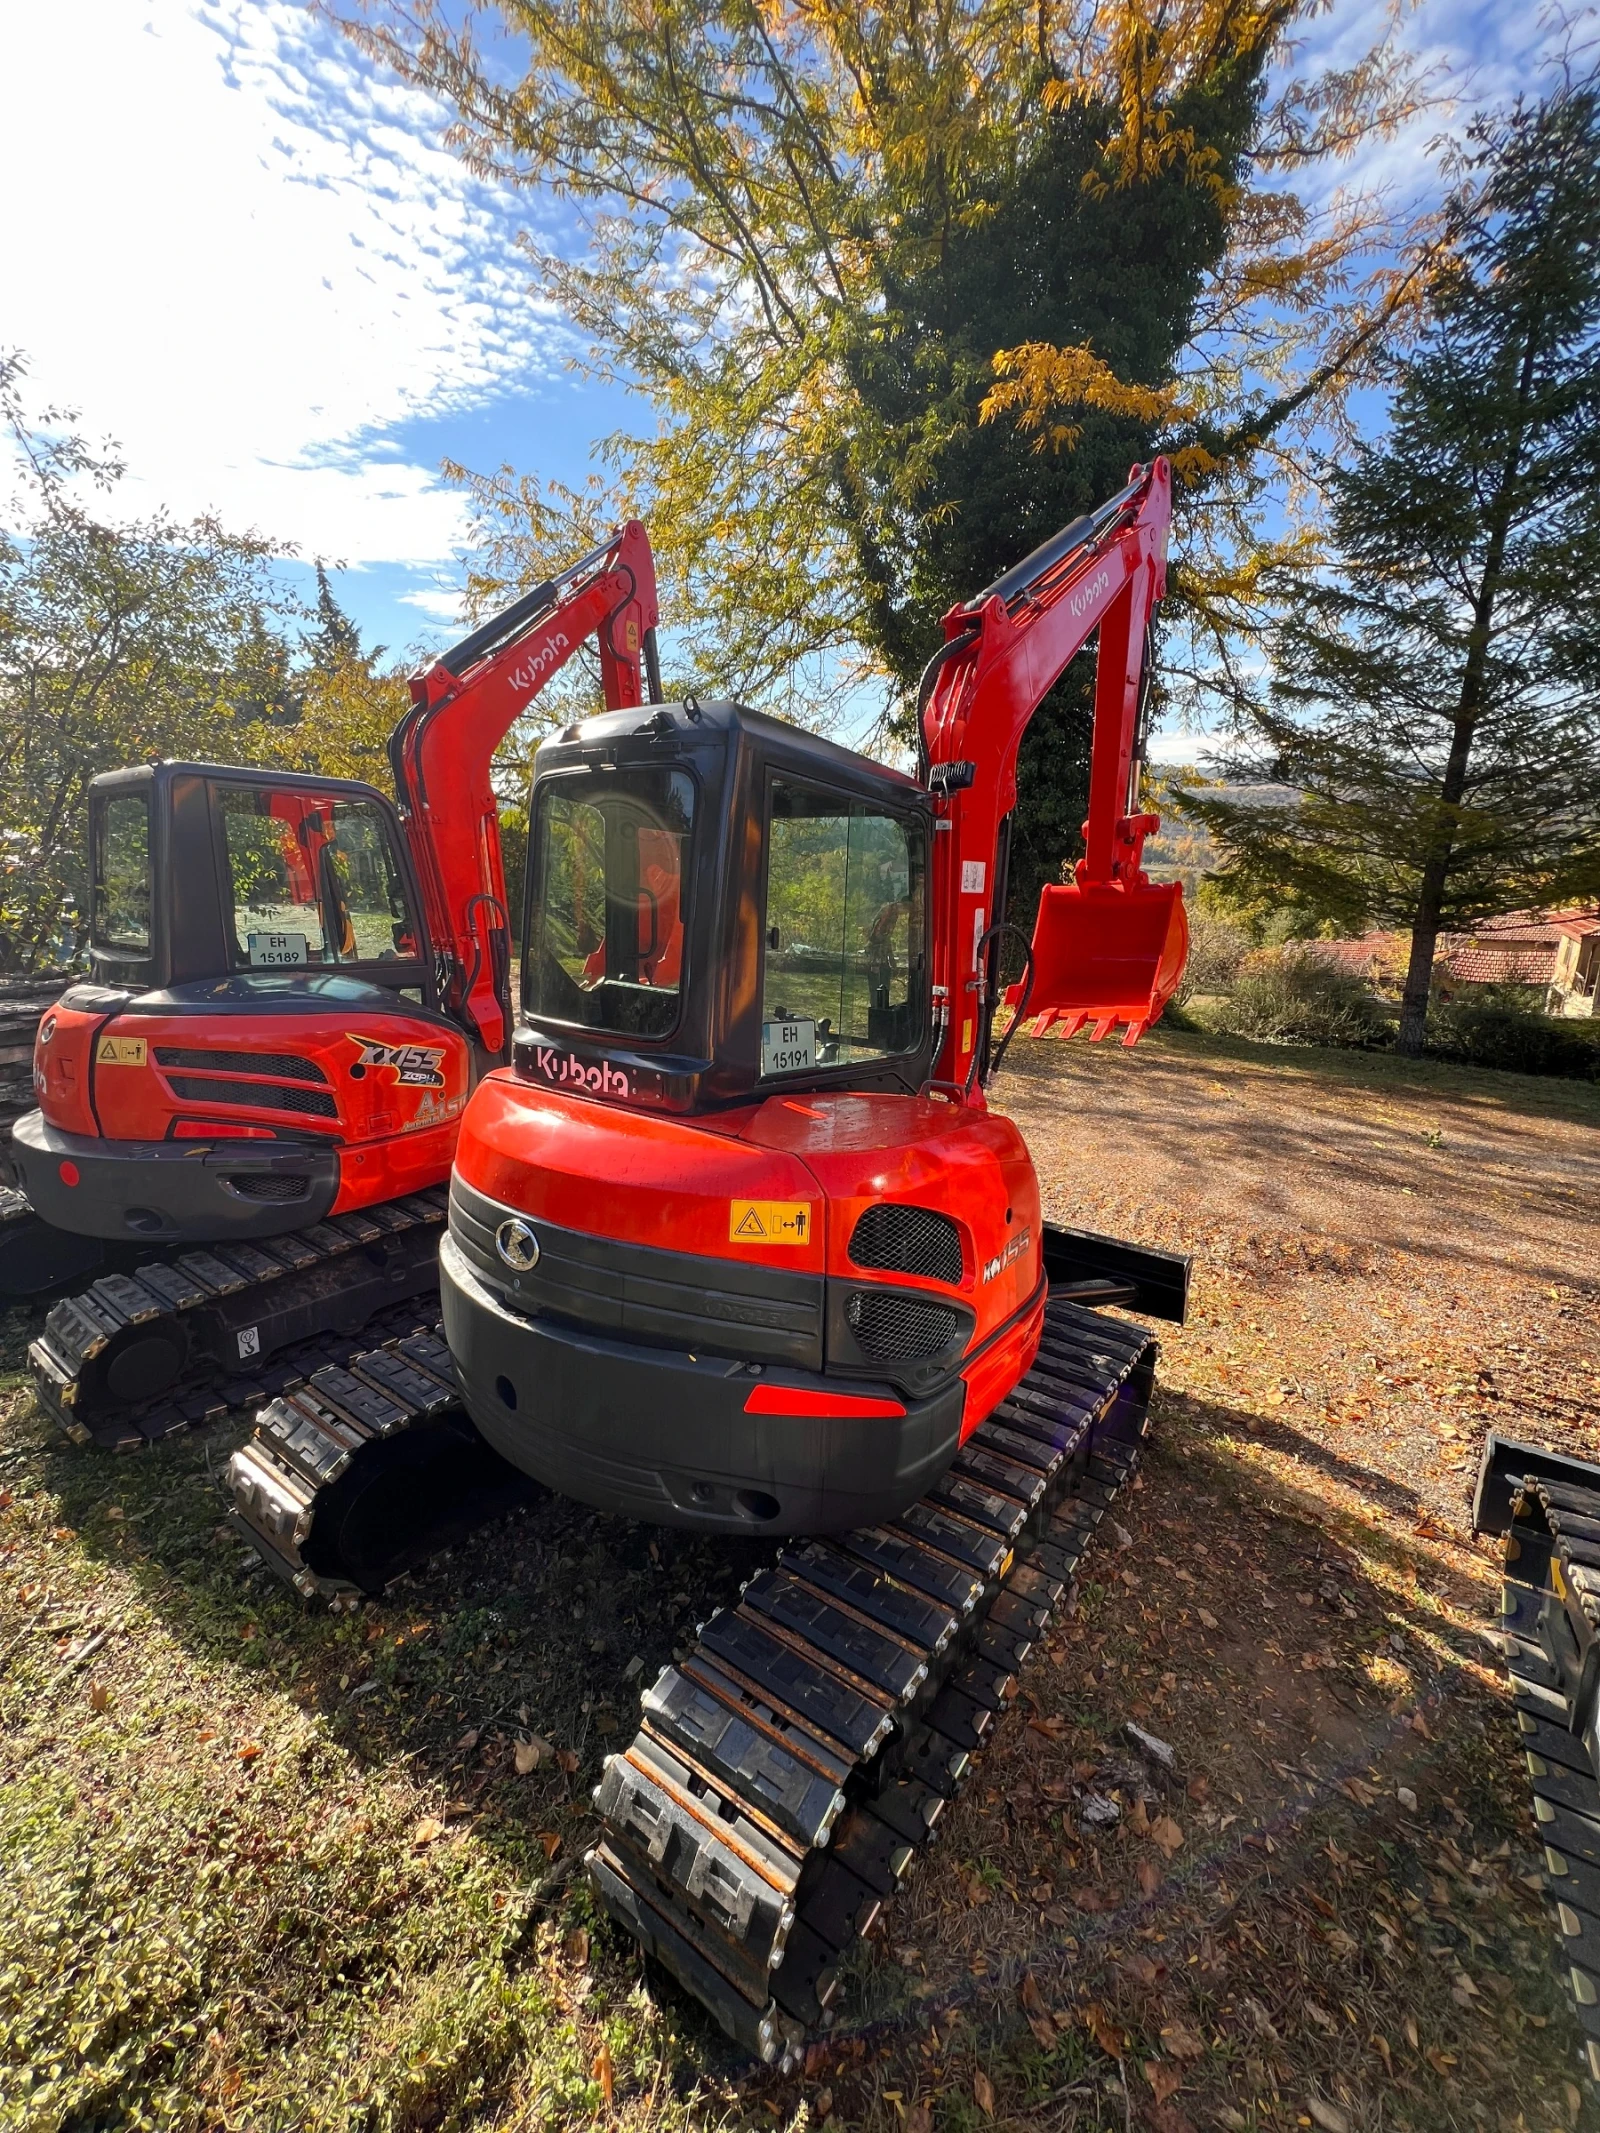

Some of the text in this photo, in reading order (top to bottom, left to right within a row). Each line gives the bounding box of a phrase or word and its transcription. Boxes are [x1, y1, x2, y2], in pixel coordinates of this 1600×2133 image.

[1071, 572, 1109, 616] Kubota
[508, 633, 569, 690] Kubota
[270, 937, 287, 947] EH
[260, 952, 299, 963] 15189
[783, 1026, 798, 1043] EH
[360, 1046, 443, 1070] KX155
[773, 1050, 808, 1069] 15191
[537, 1047, 629, 1097] Kubota
